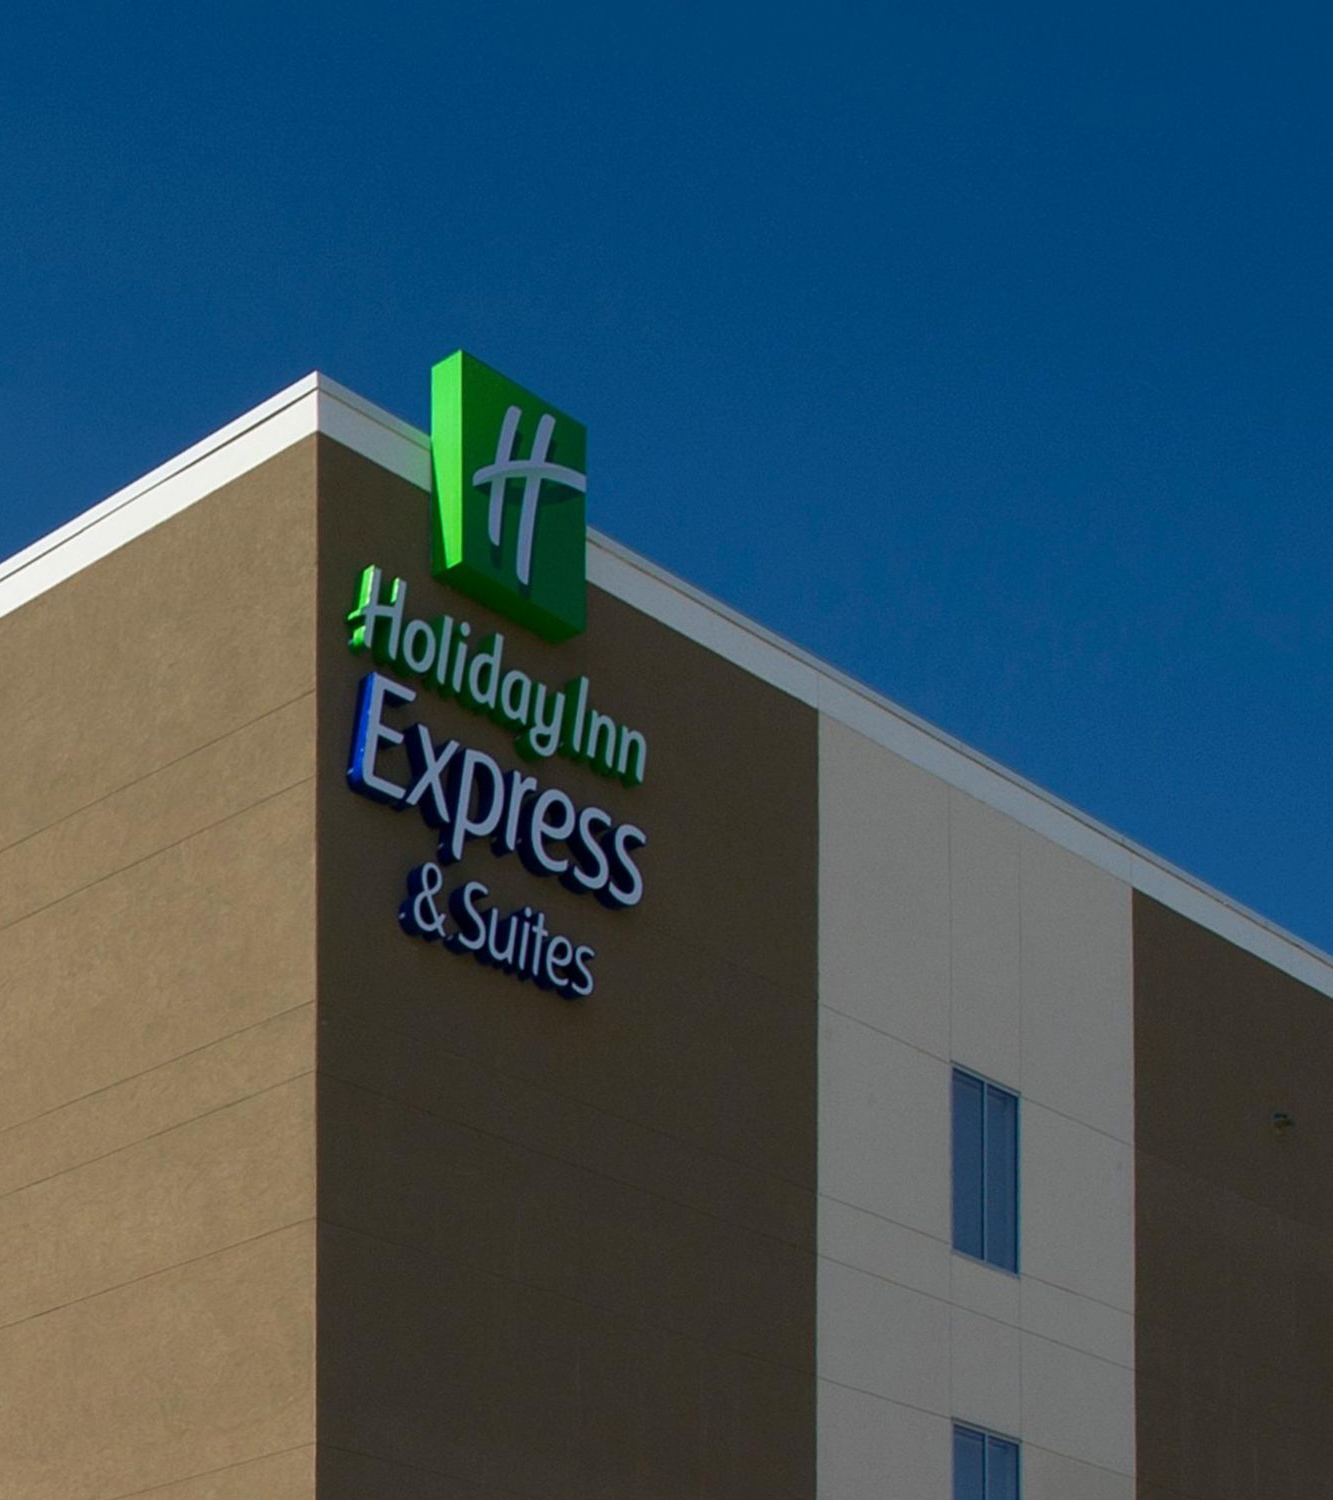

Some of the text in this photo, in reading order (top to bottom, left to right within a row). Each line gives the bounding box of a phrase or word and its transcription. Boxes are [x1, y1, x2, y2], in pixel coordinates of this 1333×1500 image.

[349, 564, 648, 784] Holiday Inn
[355, 671, 647, 905] Express
[411, 861, 596, 997] & Suites
